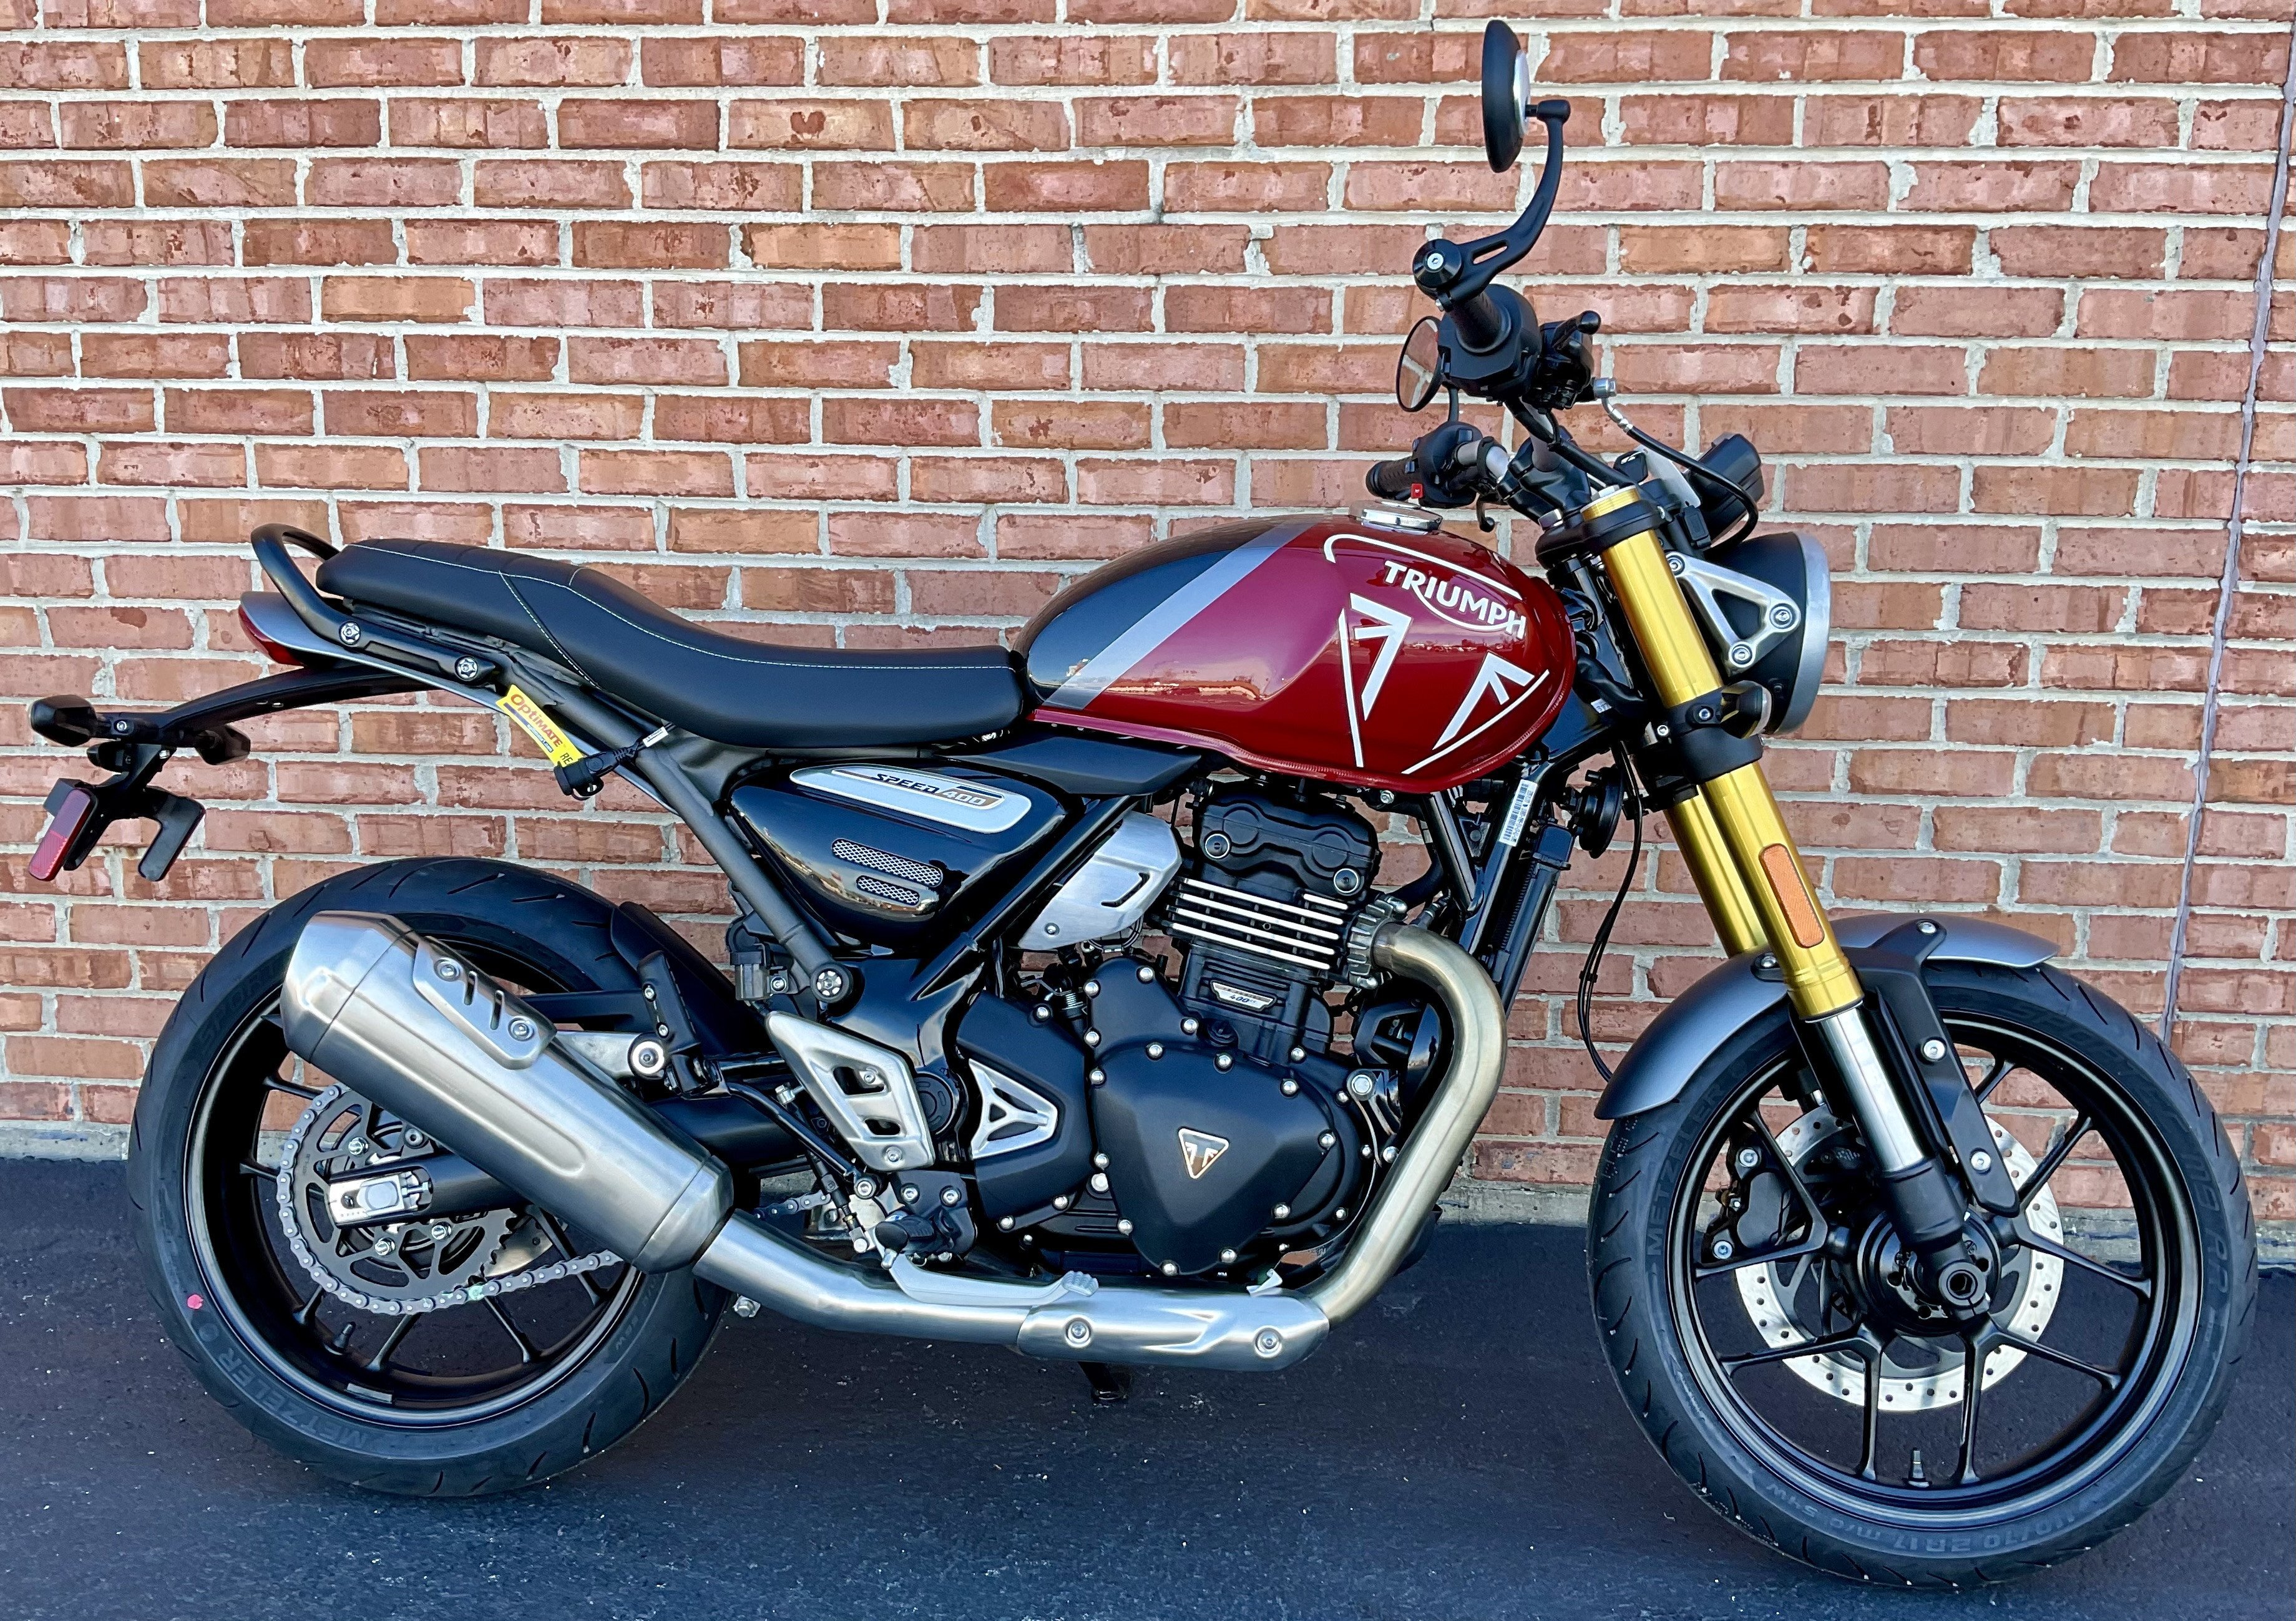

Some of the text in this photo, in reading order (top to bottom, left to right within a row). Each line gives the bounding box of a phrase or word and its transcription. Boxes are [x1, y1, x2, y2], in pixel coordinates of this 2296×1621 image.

[1384, 560, 1527, 640] TRIUMPH
[872, 774, 986, 805] SPEED 400
[1647, 1084, 1726, 1255] METZELER
[218, 1347, 366, 1448] METZELER
